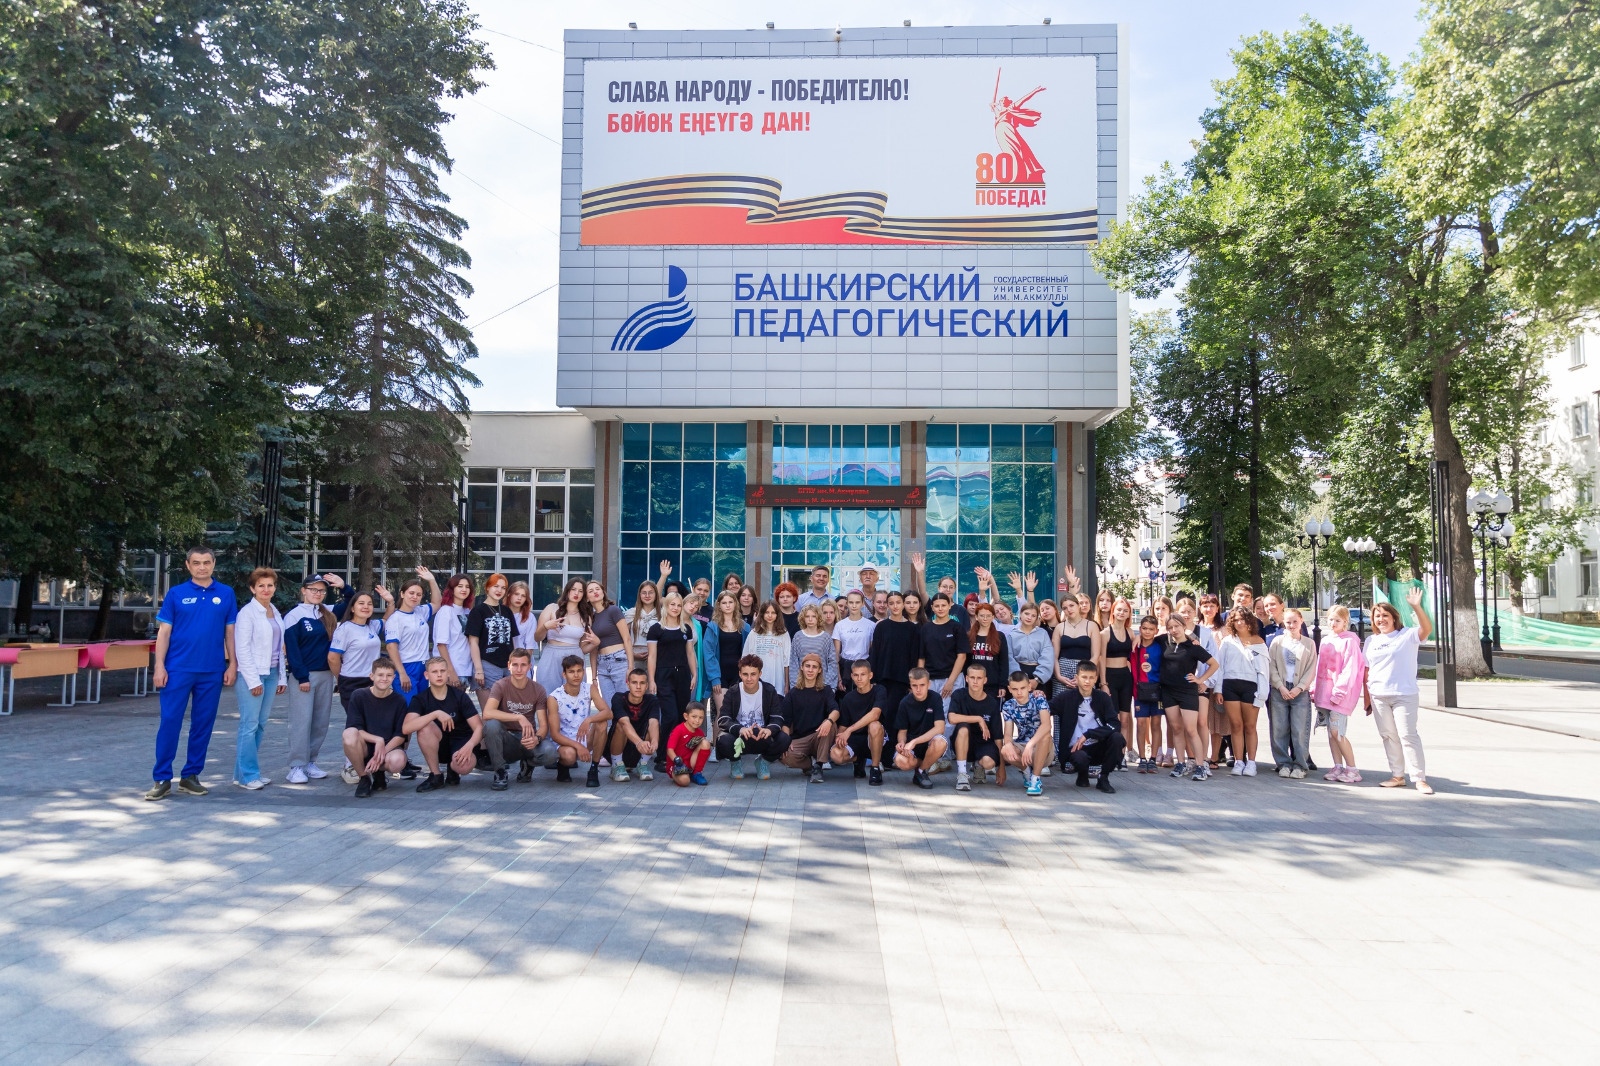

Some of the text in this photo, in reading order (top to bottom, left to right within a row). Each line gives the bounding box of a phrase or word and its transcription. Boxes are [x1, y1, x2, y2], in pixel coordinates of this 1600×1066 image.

[608, 80, 670, 103] СЛАВА
[675, 79, 752, 105] НАРОДУ
[771, 79, 909, 104] ПОБЕДИТЕЛЮ!
[607, 110, 811, 136] БӨЙӨК ЕҢЕҮГӘ ДАН!
[975, 152, 1014, 184] 80
[975, 189, 1046, 208] ПОБЕДА!
[735, 266, 980, 301] БАШКИРСКИЙ
[993, 275, 1069, 285] ГОСУДАРСТВЕННЫЙ
[993, 285, 1069, 293] УНИВЕРСИТЕТ
[993, 293, 1010, 301] ИМ.
[735, 301, 1069, 342] ПЕДАГОГИЧЕСКИЙ
[972, 642, 992, 651] ERFE
